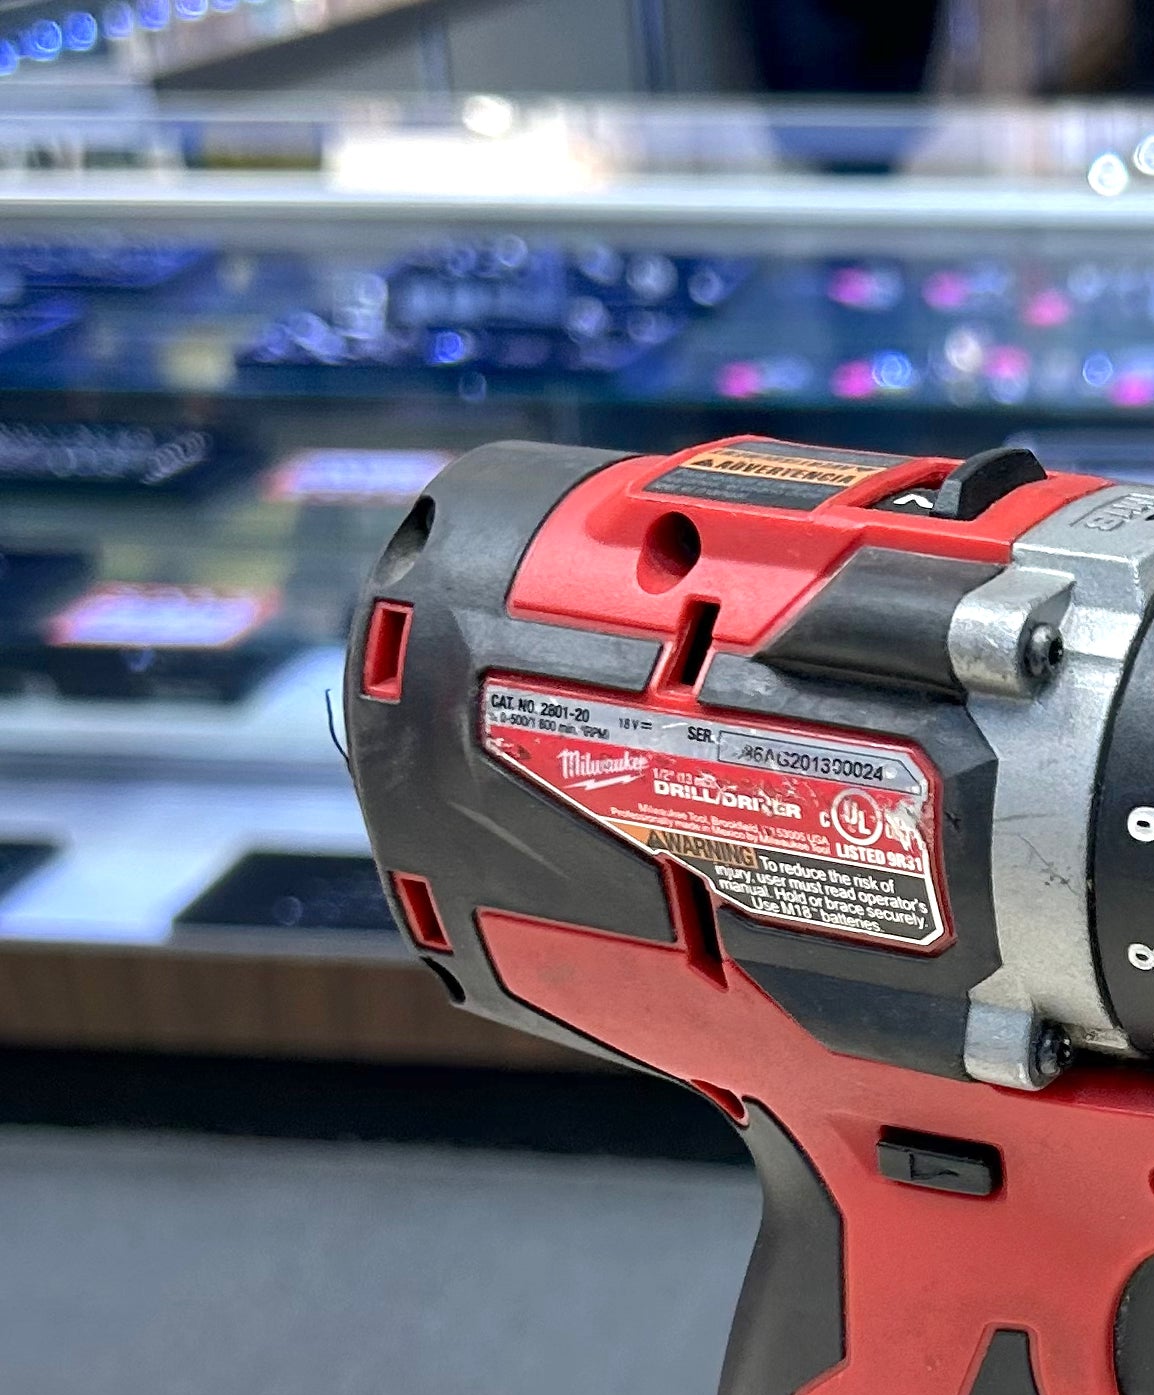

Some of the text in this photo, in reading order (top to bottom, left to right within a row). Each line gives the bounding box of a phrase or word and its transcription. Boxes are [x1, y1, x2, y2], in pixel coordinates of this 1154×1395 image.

[715, 460, 857, 484] ADVERTENCIA
[541, 702, 590, 723] 2801-20
[556, 748, 649, 779] Milwaukee
[843, 797, 871, 836] UL
[665, 830, 756, 864] WARNING
[836, 842, 886, 865] LISTED
[715, 864, 928, 914] injury, user must read operator's
[759, 856, 894, 894] To reduce the risk of
[719, 878, 929, 929] manual. Hold or brace securely.
[751, 896, 780, 913] Use
[820, 908, 885, 933] batteries.
